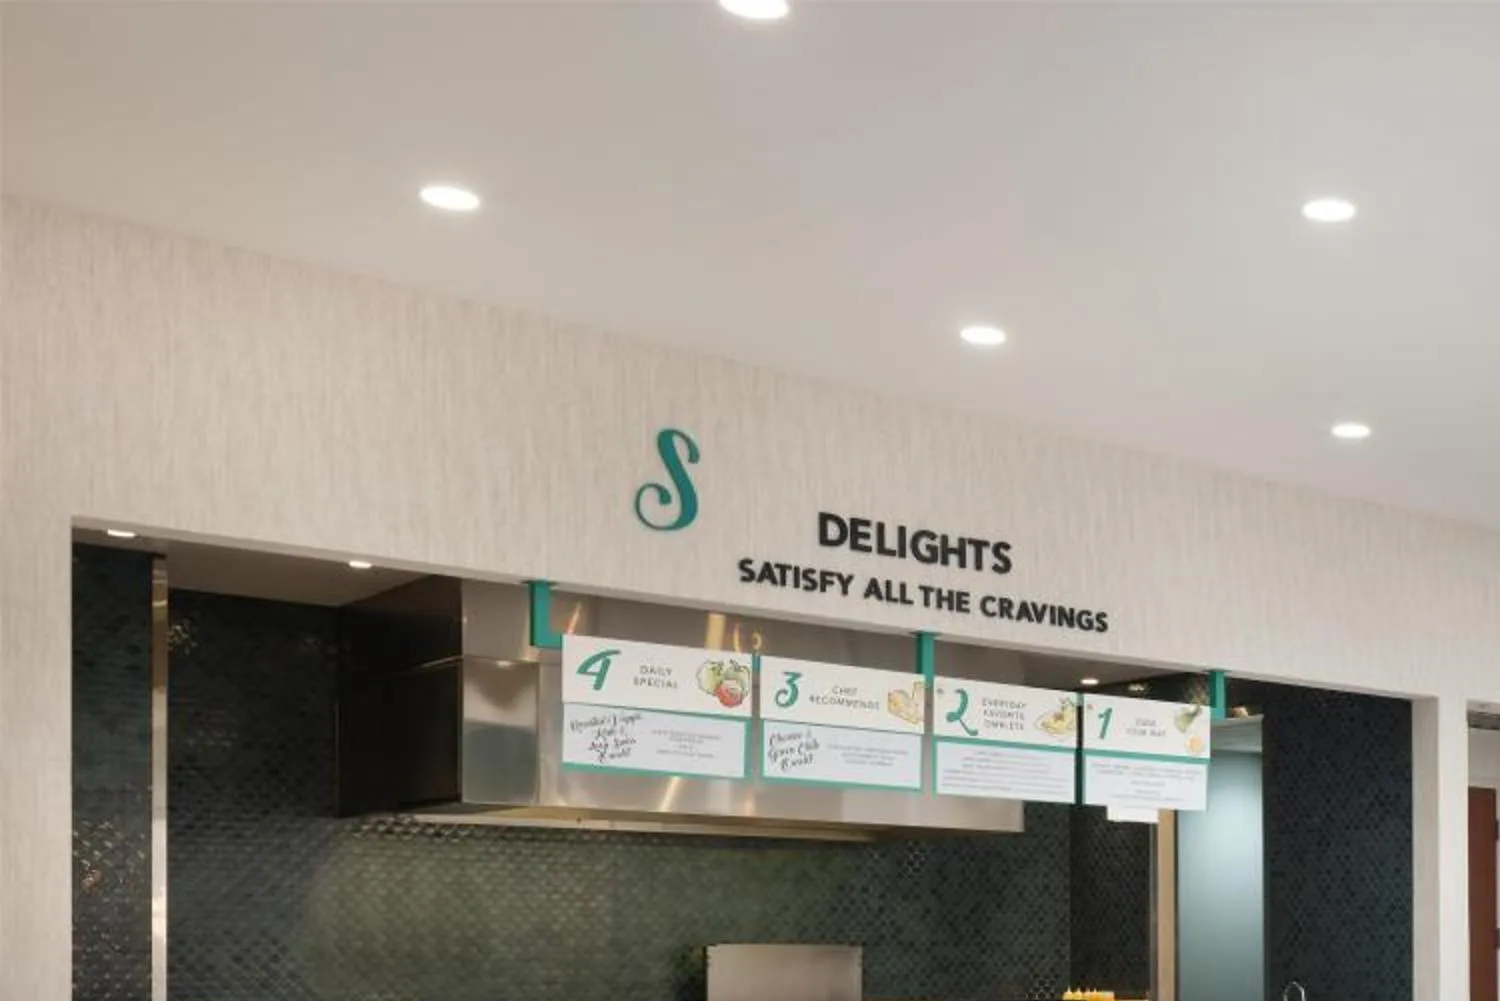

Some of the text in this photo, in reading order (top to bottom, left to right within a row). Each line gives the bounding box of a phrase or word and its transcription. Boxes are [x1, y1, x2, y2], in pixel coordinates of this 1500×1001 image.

[634, 428, 700, 532] S
[817, 511, 1012, 574] DELIGHTS
[738, 558, 1108, 633] SATISFY ALL THE CRAVINGS
[576, 649, 621, 691] 4
[633, 676, 678, 689] SPECIAL
[639, 664, 673, 676] DAILY
[775, 671, 802, 708] 3
[945, 688, 979, 736] 2
[1098, 707, 1113, 740] 1
